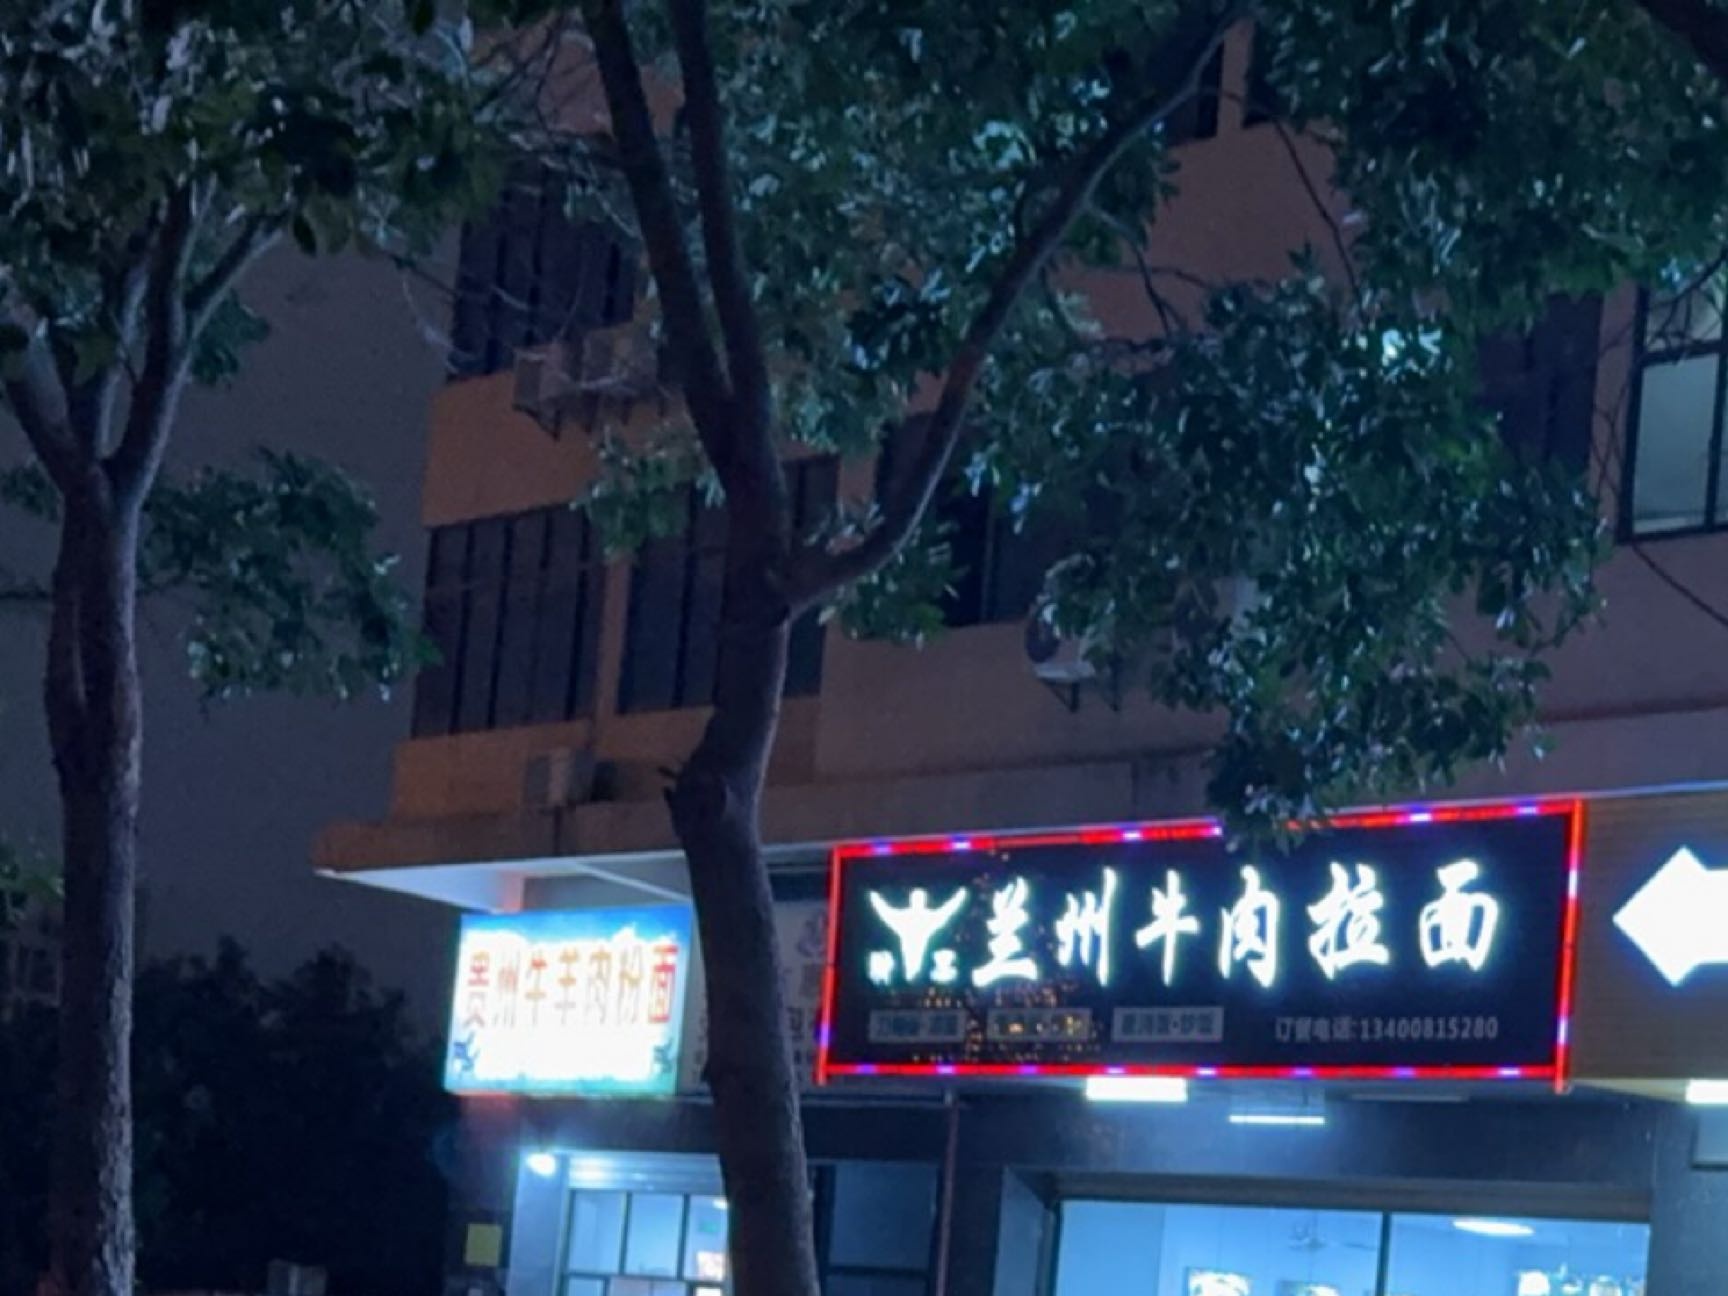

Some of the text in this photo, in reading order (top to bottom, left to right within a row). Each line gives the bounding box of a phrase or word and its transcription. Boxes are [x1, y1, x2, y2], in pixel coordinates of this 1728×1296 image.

[971, 859, 1500, 988] 兰州牛肉拉面
